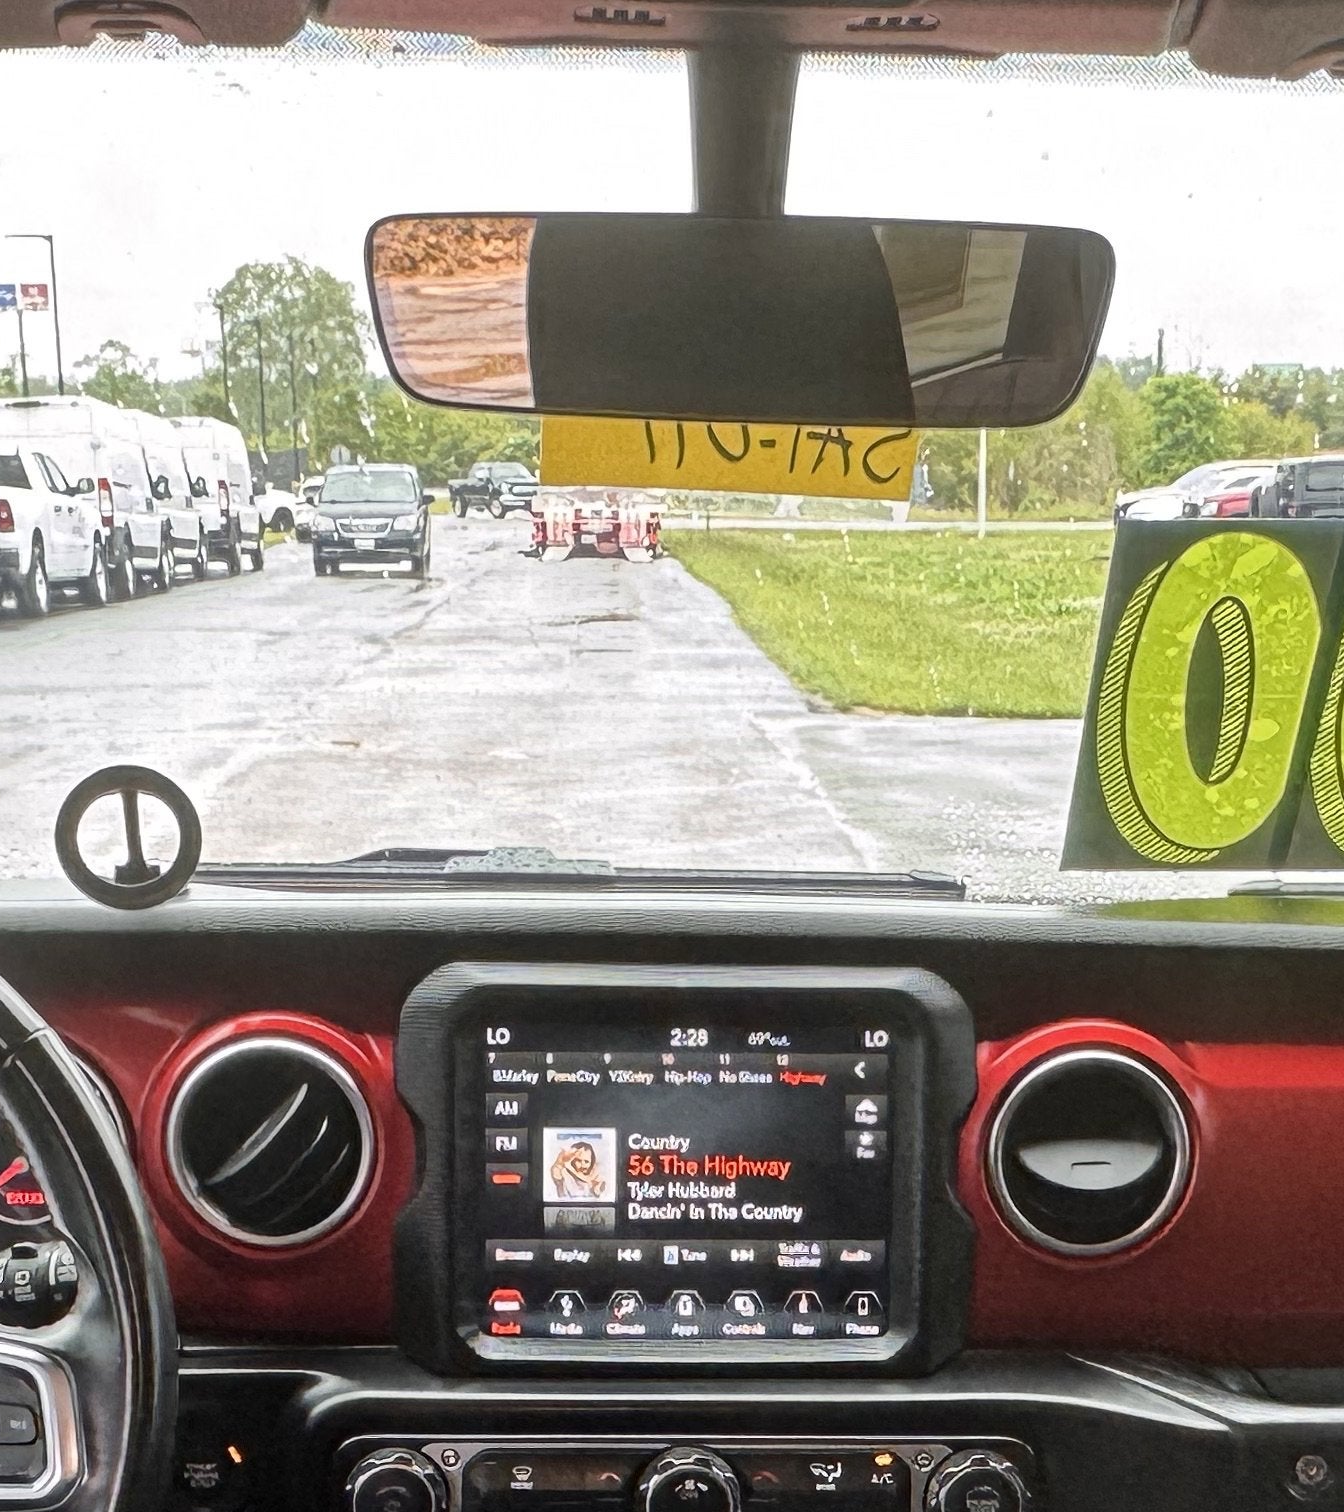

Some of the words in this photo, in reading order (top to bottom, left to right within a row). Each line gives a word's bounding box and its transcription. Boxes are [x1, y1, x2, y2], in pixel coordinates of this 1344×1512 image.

[486, 1027, 511, 1045] LO
[669, 1027, 709, 1047] 2:28
[864, 1029, 890, 1048] LO
[627, 1132, 691, 1153] Country
[627, 1154, 655, 1176] 56
[658, 1154, 699, 1177] The
[703, 1154, 792, 1181] Highway
[627, 1181, 665, 1201] Tyler
[667, 1181, 737, 1200] Hubbard
[627, 1202, 686, 1220] Dancin'
[708, 1203, 738, 1220] The
[741, 1202, 804, 1223] Country
